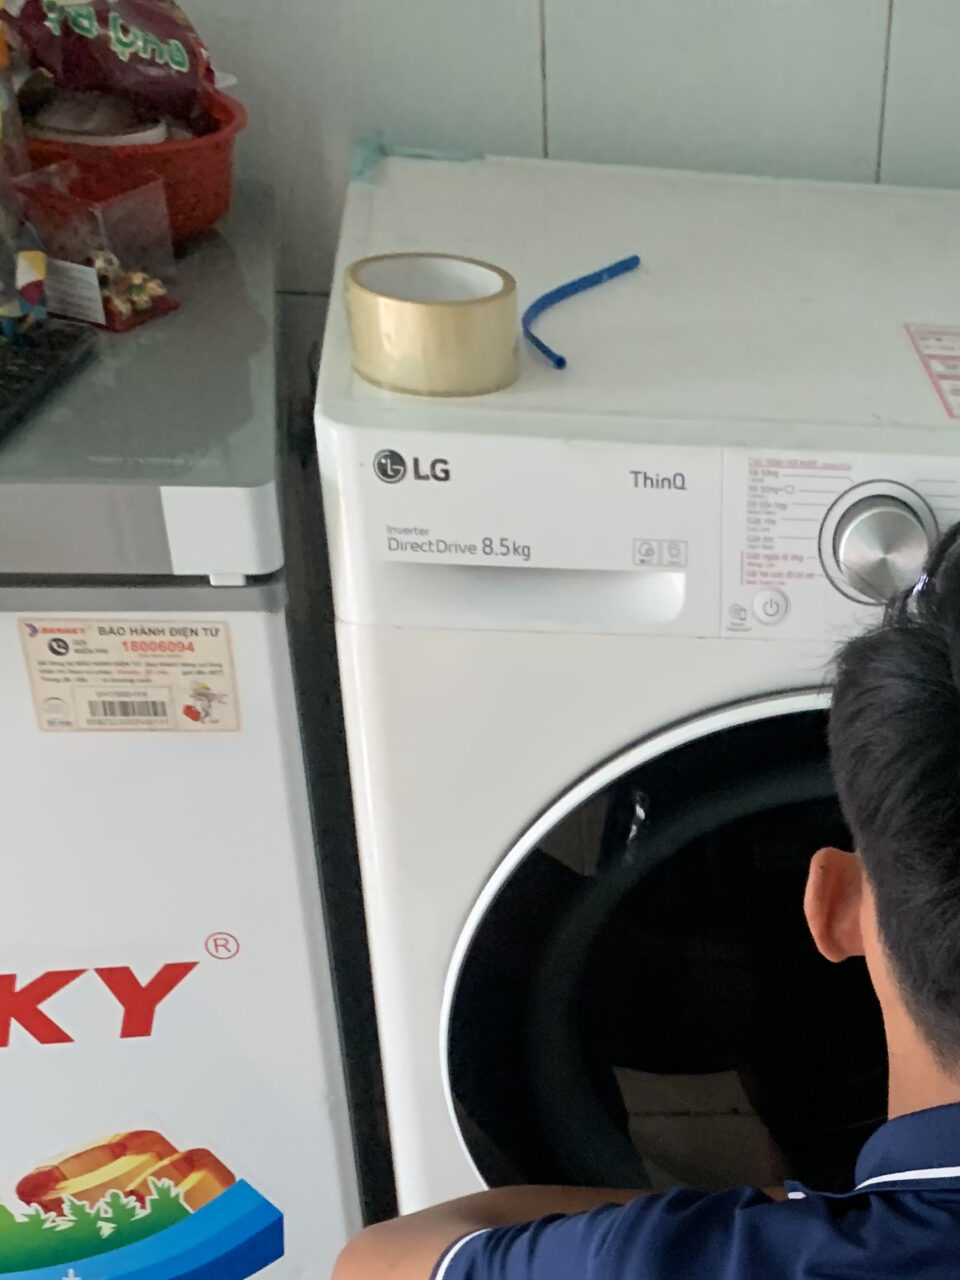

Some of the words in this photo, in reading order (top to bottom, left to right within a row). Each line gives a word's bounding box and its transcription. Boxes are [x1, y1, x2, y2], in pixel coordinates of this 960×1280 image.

[413, 457, 450, 481] LG
[629, 470, 687, 490] ThinQ
[386, 525, 429, 536] Inverter
[129, 625, 166, 636] HÀNH
[122, 640, 195, 652] 18006094
